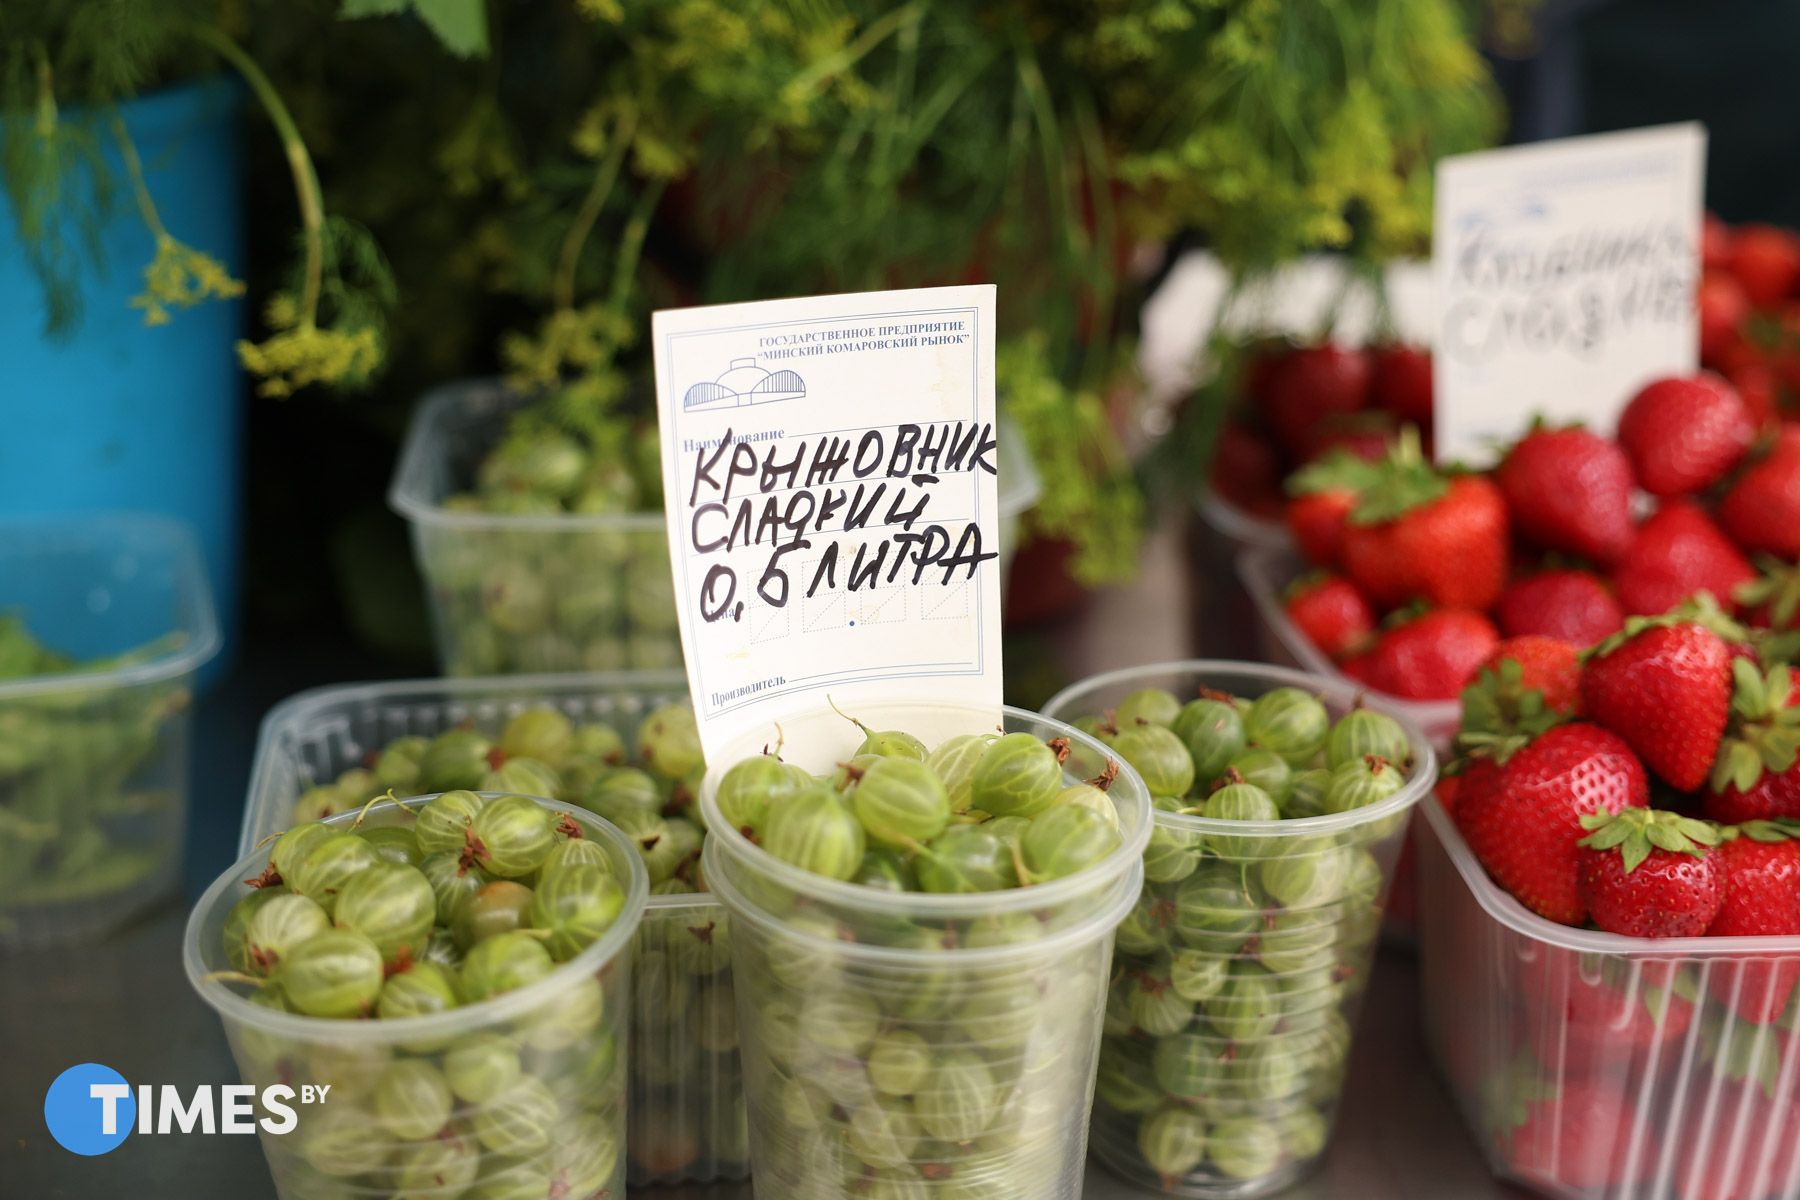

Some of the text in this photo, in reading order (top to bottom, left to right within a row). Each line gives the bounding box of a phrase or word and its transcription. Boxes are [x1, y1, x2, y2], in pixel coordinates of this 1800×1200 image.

[759, 321, 966, 348] ГОСУДАРСТВЕННОЕ ПРЕДПРИЯТИЕ
[826, 335, 918, 354] КОМАРОВСКИЙ
[683, 429, 785, 453] Наимнование
[689, 421, 998, 508] КРЫЖОВНИК
[690, 473, 940, 556] СЛАДКИЙ
[805, 522, 1000, 599] ЛИТРА
[711, 674, 787, 707] Производитель
